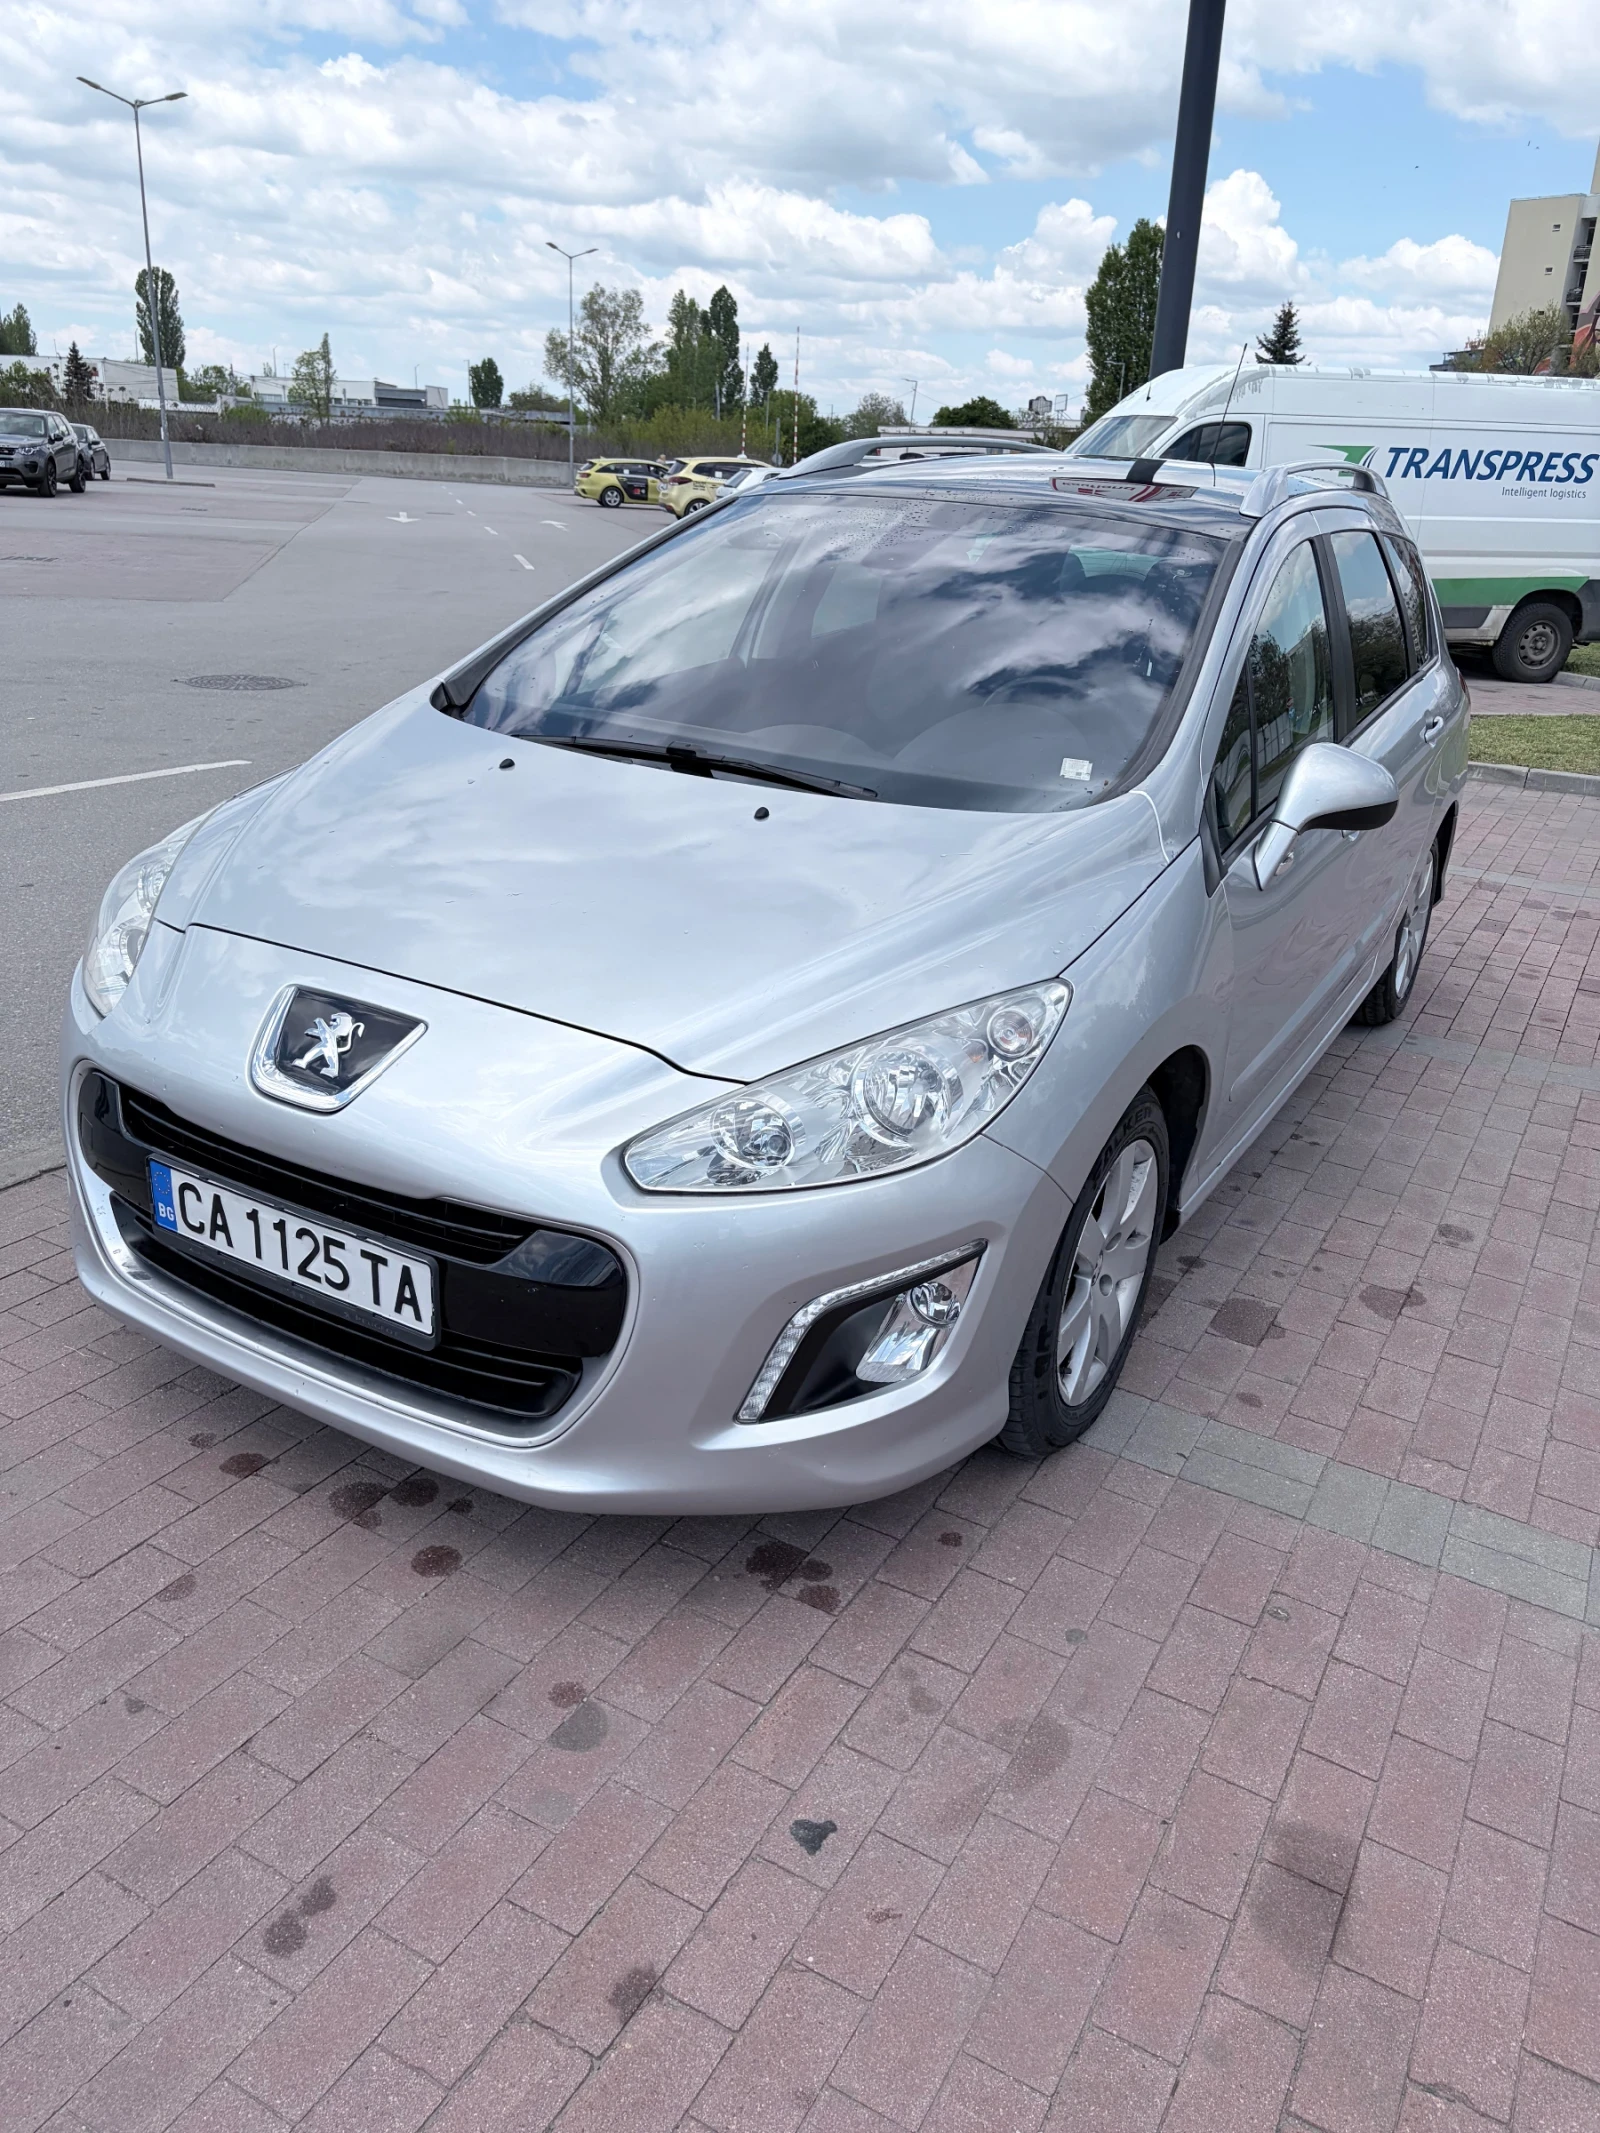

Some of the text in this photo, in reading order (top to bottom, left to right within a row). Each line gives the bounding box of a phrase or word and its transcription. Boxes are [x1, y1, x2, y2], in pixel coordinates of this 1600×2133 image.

[1384, 447, 1600, 484] TRANSPRESS
[1501, 486, 1587, 500] Intelligent logistics
[158, 1202, 175, 1221] BG
[178, 1182, 423, 1322] CA 1125 TA
